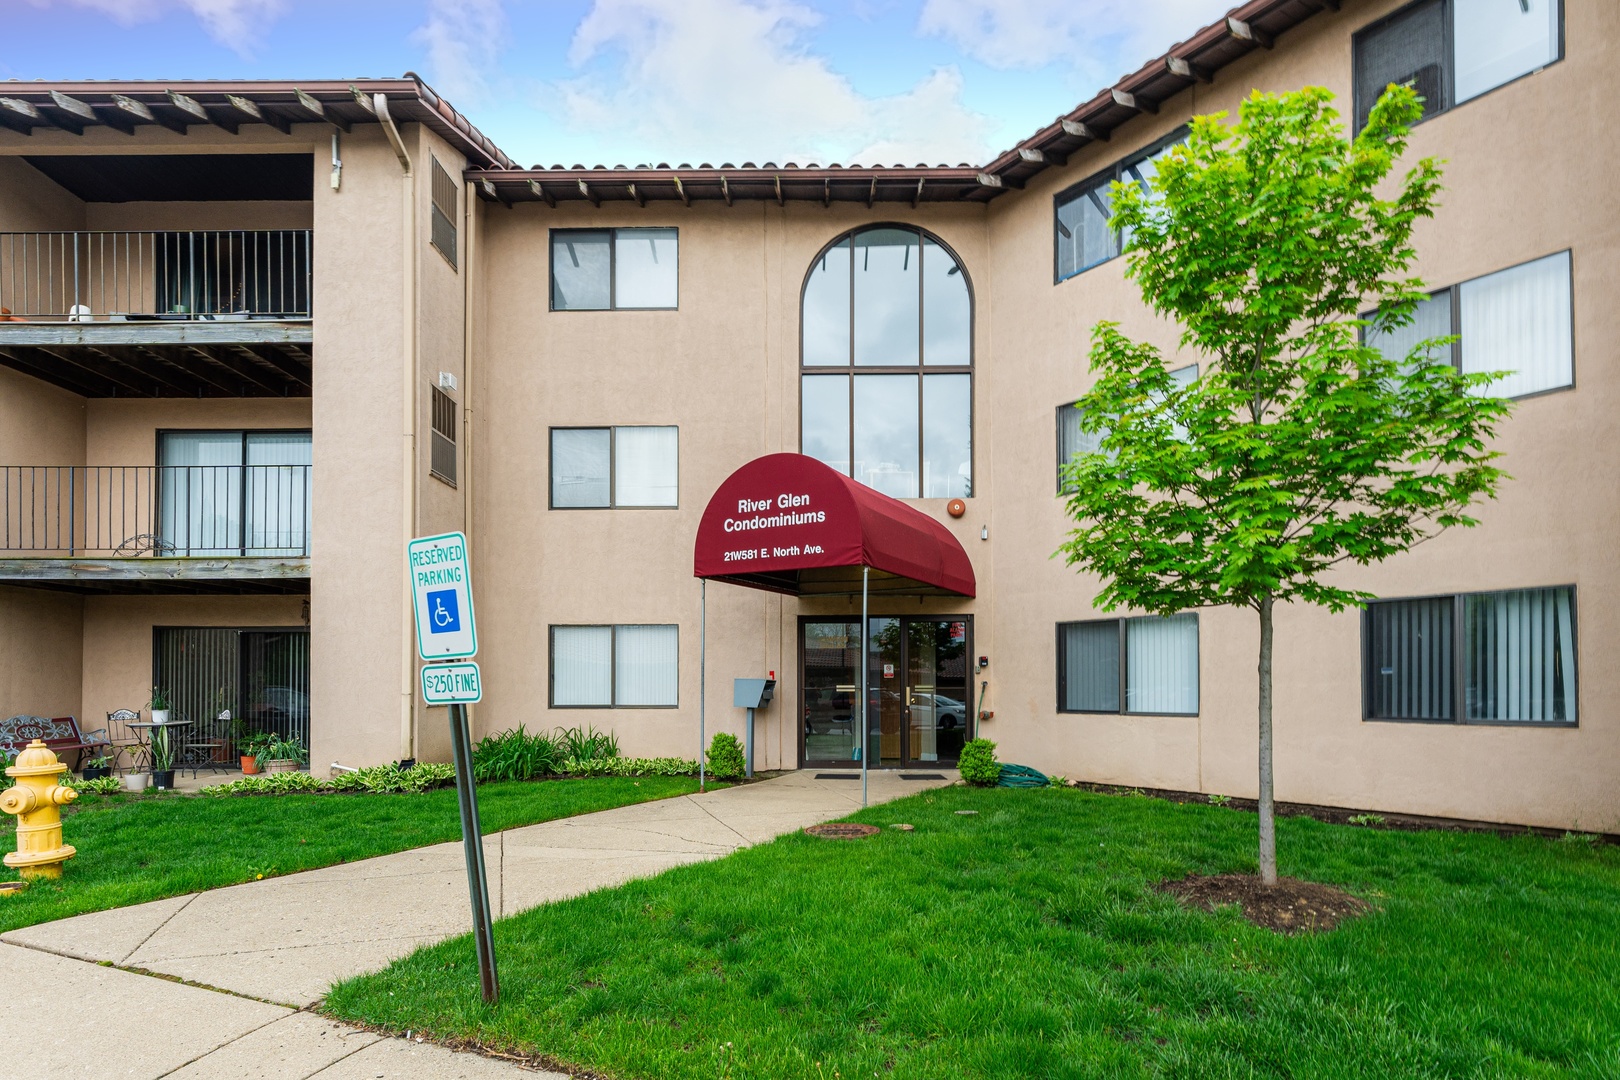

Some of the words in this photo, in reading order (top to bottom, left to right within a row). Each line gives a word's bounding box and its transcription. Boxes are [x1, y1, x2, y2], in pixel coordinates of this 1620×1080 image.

[738, 499, 772, 513] River
[777, 493, 810, 508] Glen
[724, 511, 826, 532] Condominiums
[412, 545, 462, 567] RESERVED
[724, 549, 758, 561] 21W581
[761, 548, 770, 558] E.
[773, 546, 800, 557] North
[803, 544, 825, 554] Ave.
[418, 567, 461, 587] PARKING
[426, 674, 454, 693] $250
[455, 673, 477, 693] FINE
